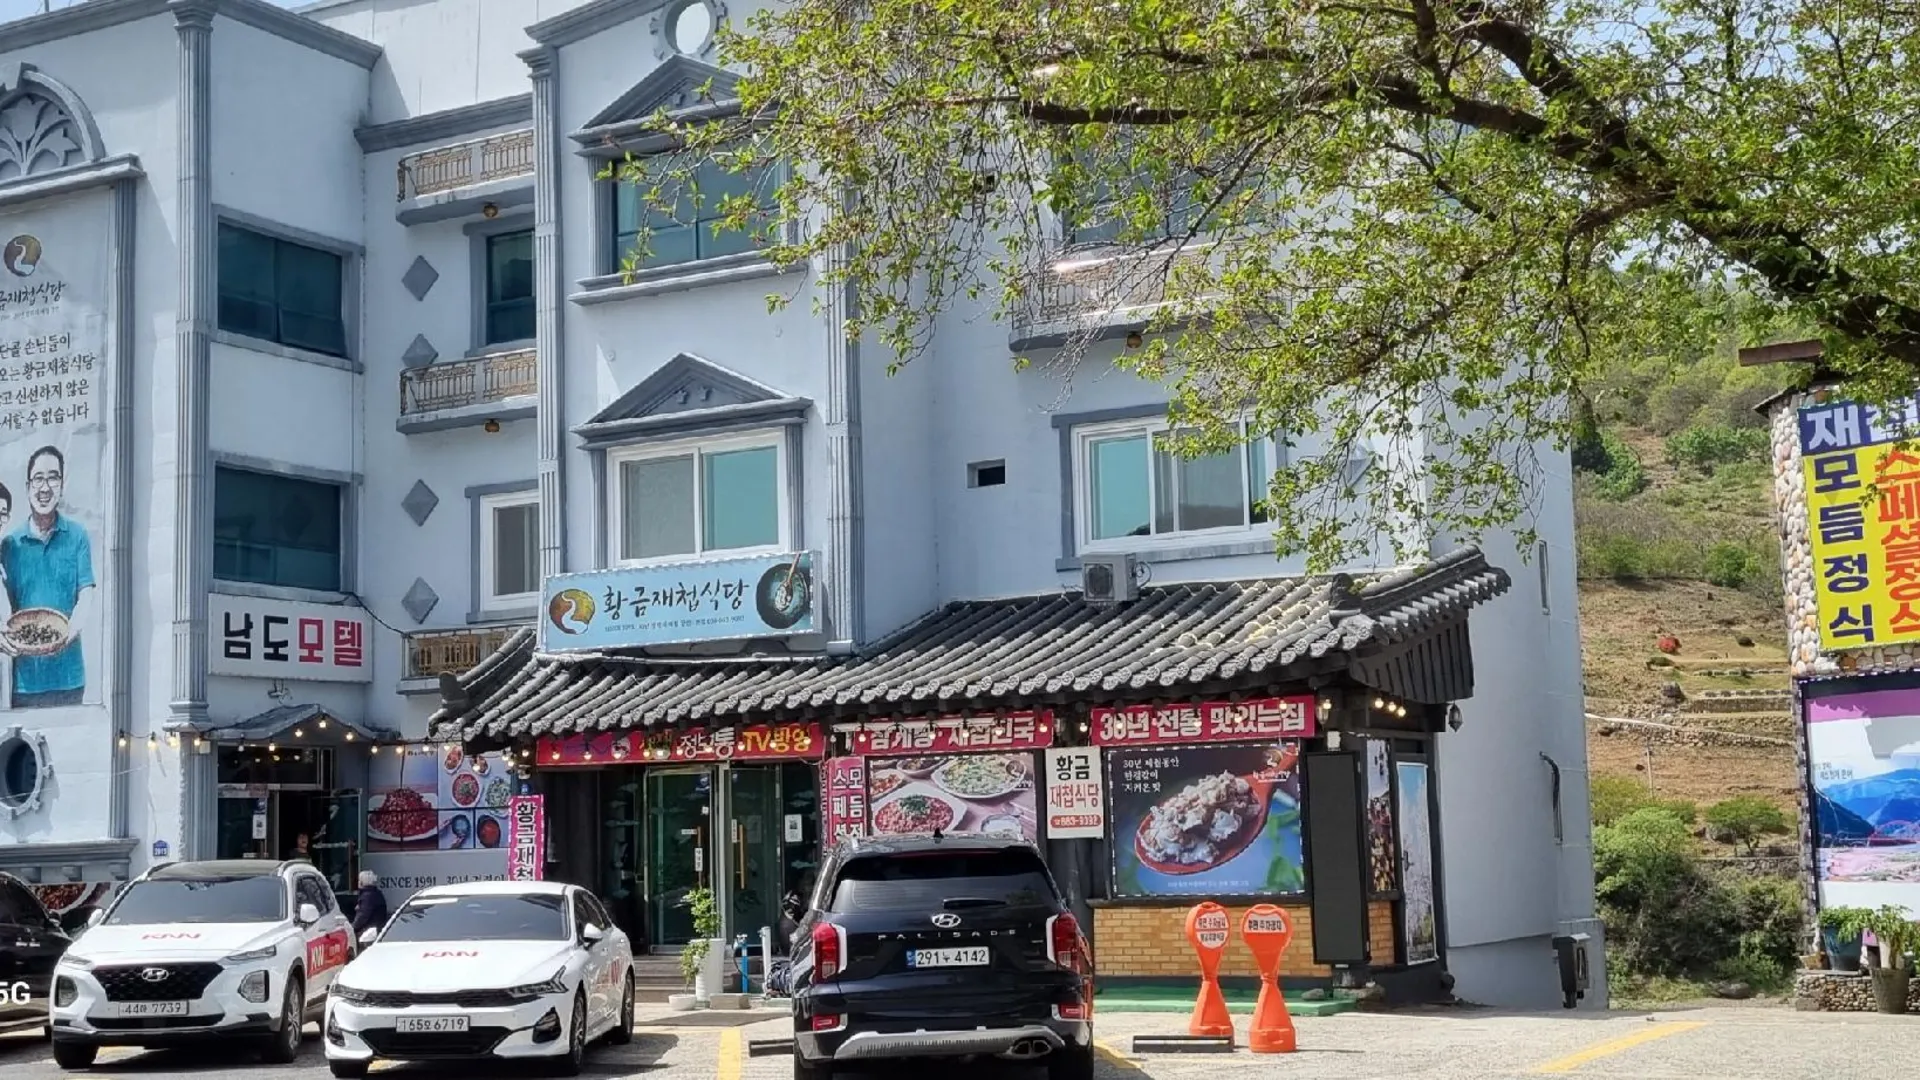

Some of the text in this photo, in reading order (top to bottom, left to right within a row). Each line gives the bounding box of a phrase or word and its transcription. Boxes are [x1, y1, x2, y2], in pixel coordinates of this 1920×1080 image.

[25, 332, 70, 355] 손님들이
[23, 352, 95, 380] 황금재첩식당
[0, 378, 89, 405] 고 신선하지 않은
[0, 411, 24, 430] 서할
[41, 401, 89, 425] 없습니다
[1814, 453, 1875, 642] 모듬정식
[603, 578, 750, 621] 황금재첩식당
[224, 611, 362, 667] 남도모텔
[1210, 702, 1305, 734] 맛있는집
[1056, 755, 1090, 781] 황금
[1049, 783, 1099, 809] 재첩식당
[379, 877, 413, 889] SINCE
[878, 930, 1016, 940] PALISADE
[954, 950, 986, 963] 4142
[152, 1002, 181, 1016] 7739
